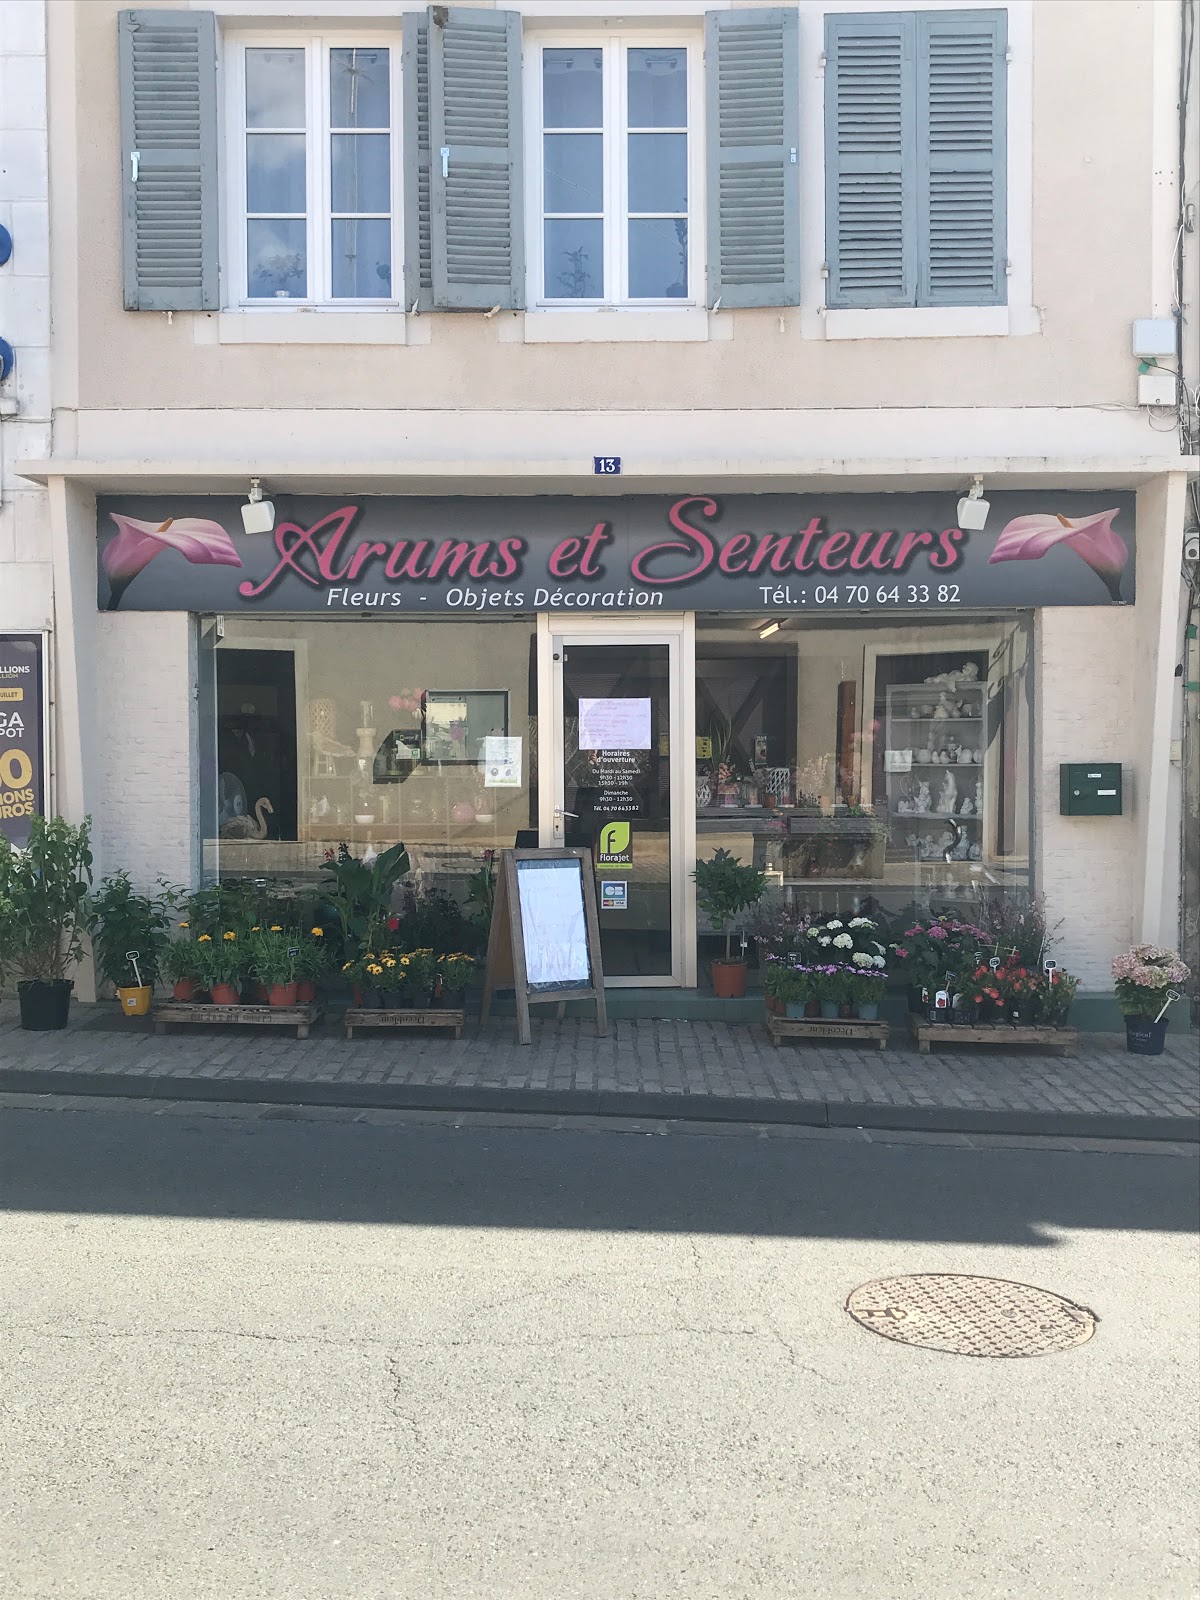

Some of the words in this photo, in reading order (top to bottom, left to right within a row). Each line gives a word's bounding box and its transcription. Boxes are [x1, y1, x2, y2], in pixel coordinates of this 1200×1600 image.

[599, 459, 616, 473] 13
[239, 505, 522, 597] Arums
[549, 523, 608, 577] et
[631, 497, 963, 583] Senteurs
[327, 588, 401, 606] Fleurs
[446, 588, 524, 611] Objets
[534, 588, 664, 607] Décoration
[759, 585, 806, 604] Tél.:
[814, 585, 839, 604] 04
[846, 585, 869, 604] 70
[876, 585, 900, 603] 64
[907, 585, 930, 603] 33
[937, 585, 961, 602] 82
[0, 748, 32, 788] 0
[600, 854, 630, 862] florajet
[605, 886, 623, 895] CB
